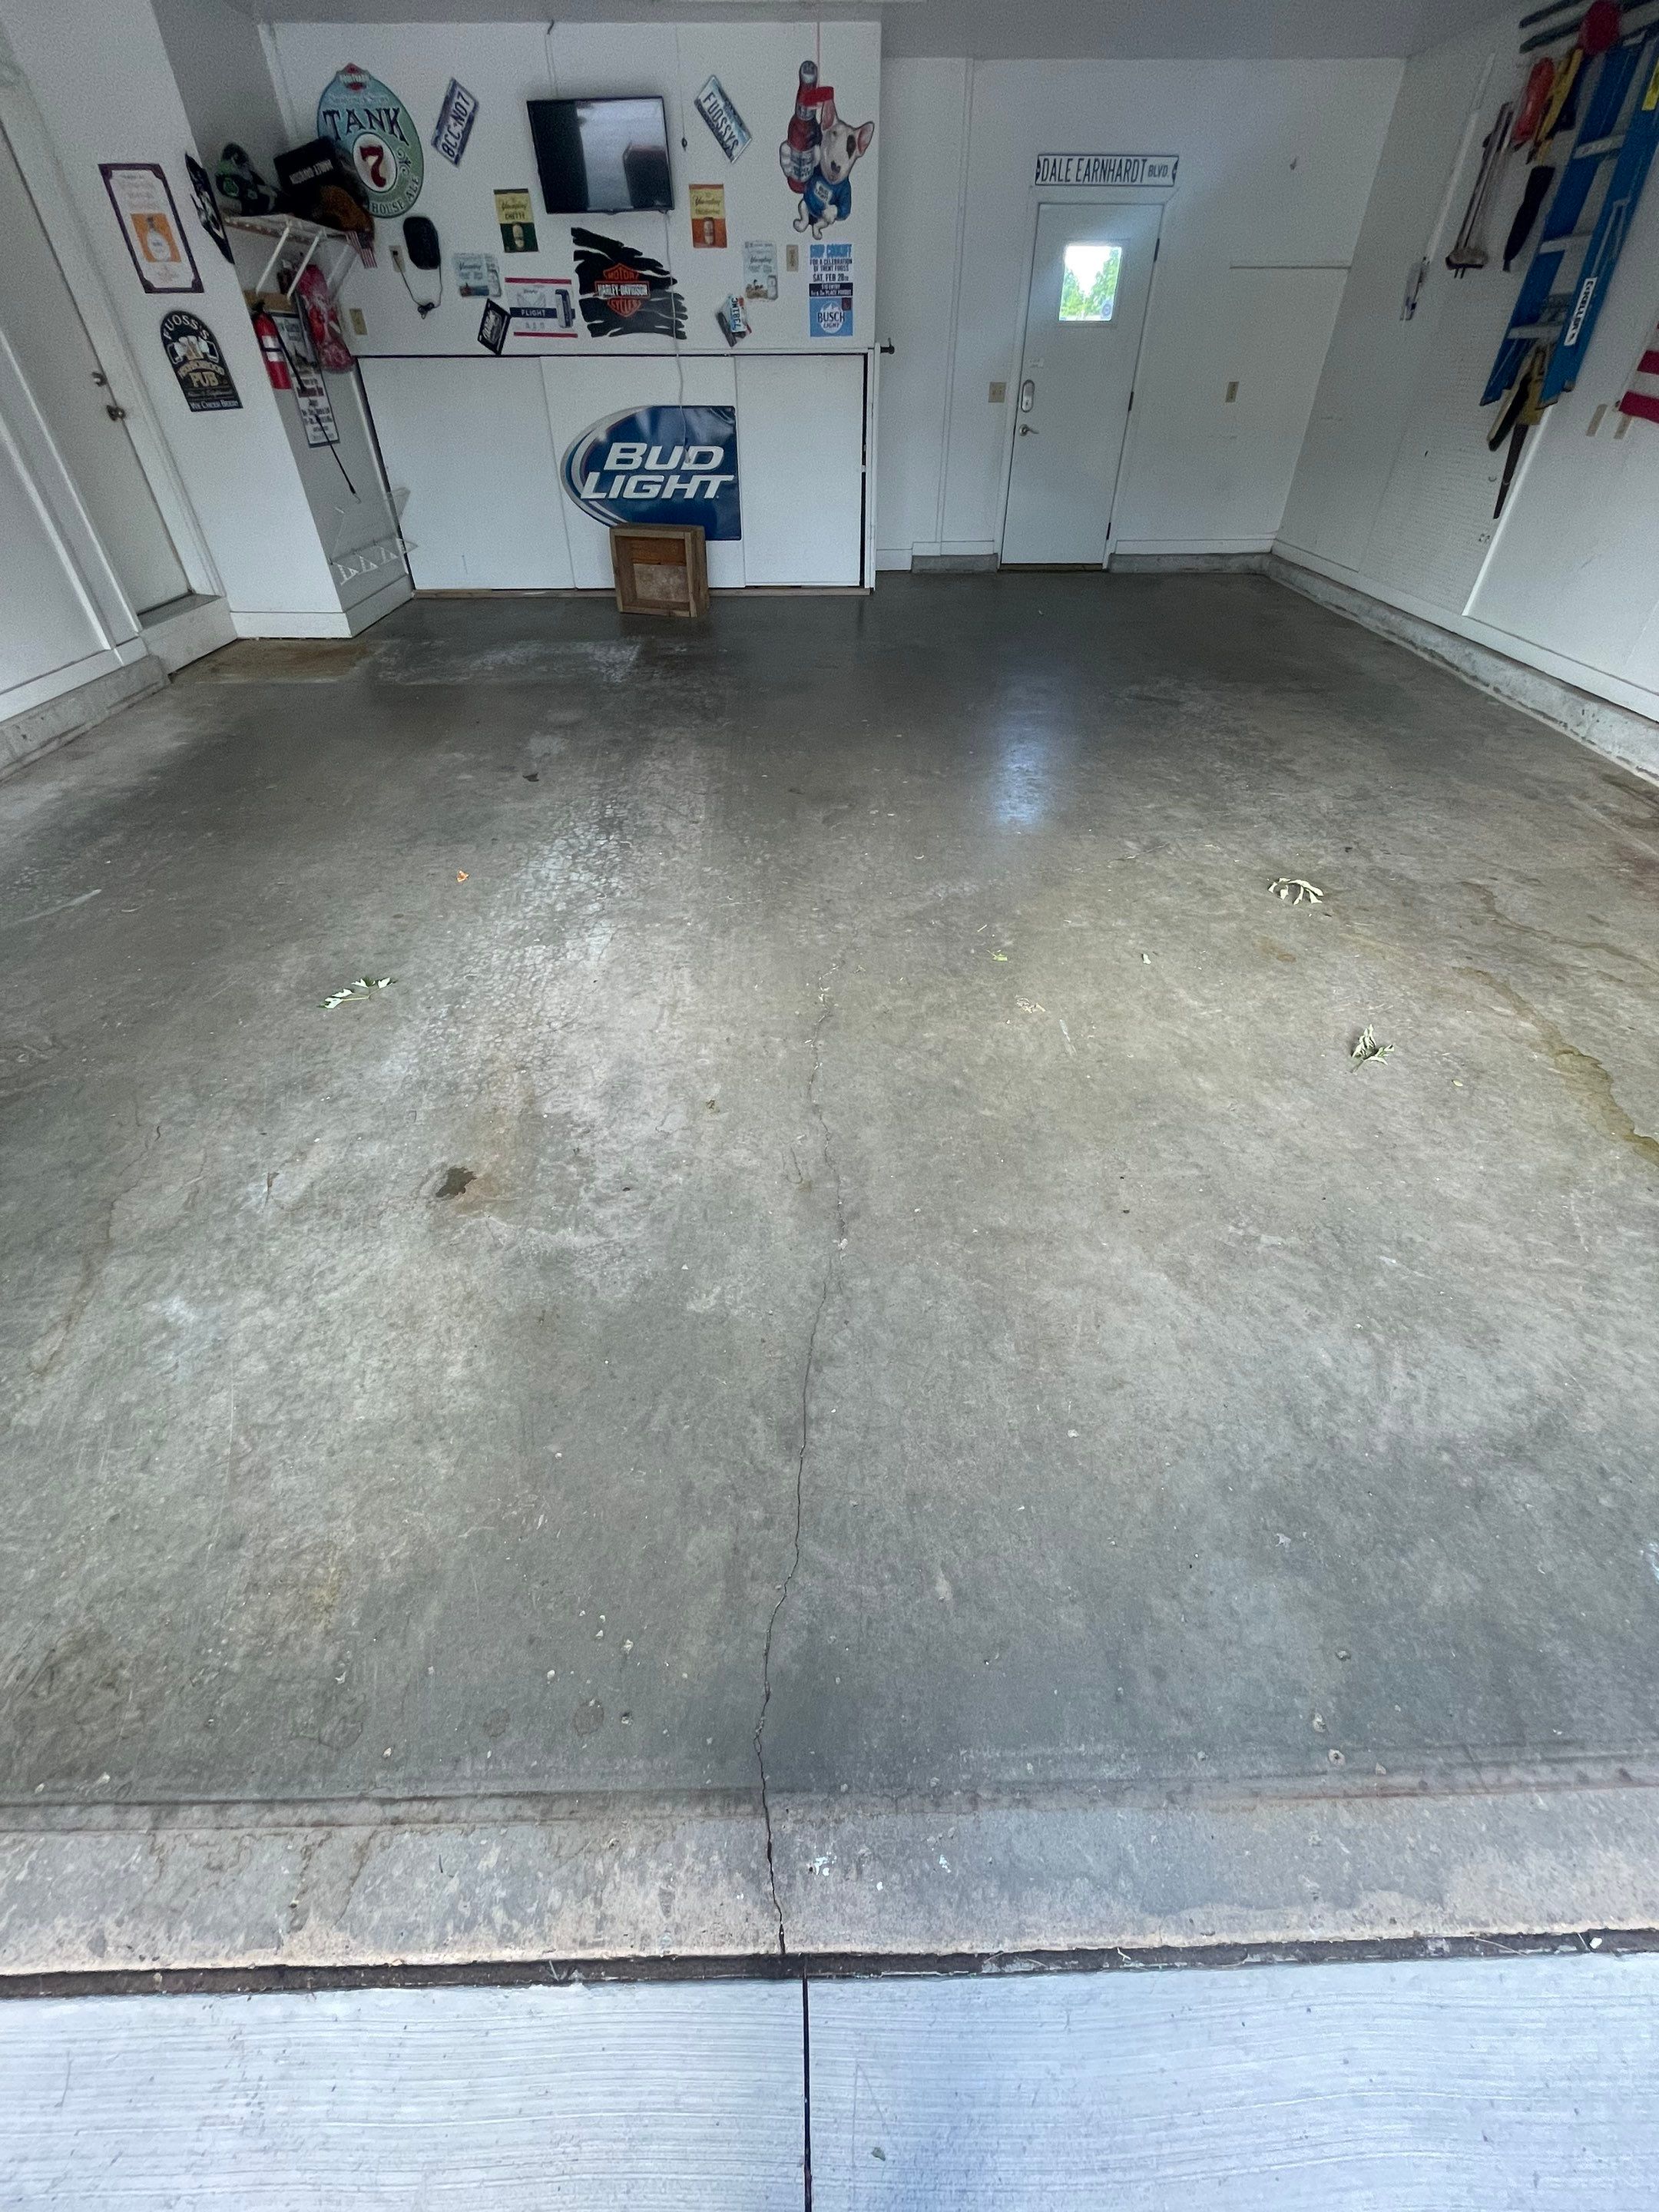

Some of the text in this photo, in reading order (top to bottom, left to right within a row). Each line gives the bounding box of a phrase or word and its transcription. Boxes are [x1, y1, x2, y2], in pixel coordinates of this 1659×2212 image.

[322, 107, 409, 146] TANK
[359, 144, 387, 188] 7
[1041, 157, 1073, 182] DALE
[1075, 157, 1147, 183] EARNHARDT
[369, 175, 420, 214] HOUSE ALE
[608, 267, 636, 280] MOTOR
[521, 309, 546, 317] FLIGHT
[817, 311, 845, 323] BUSCH
[189, 371, 219, 387] PUB
[604, 442, 724, 472] BUD
[580, 472, 735, 499] LIGHT
